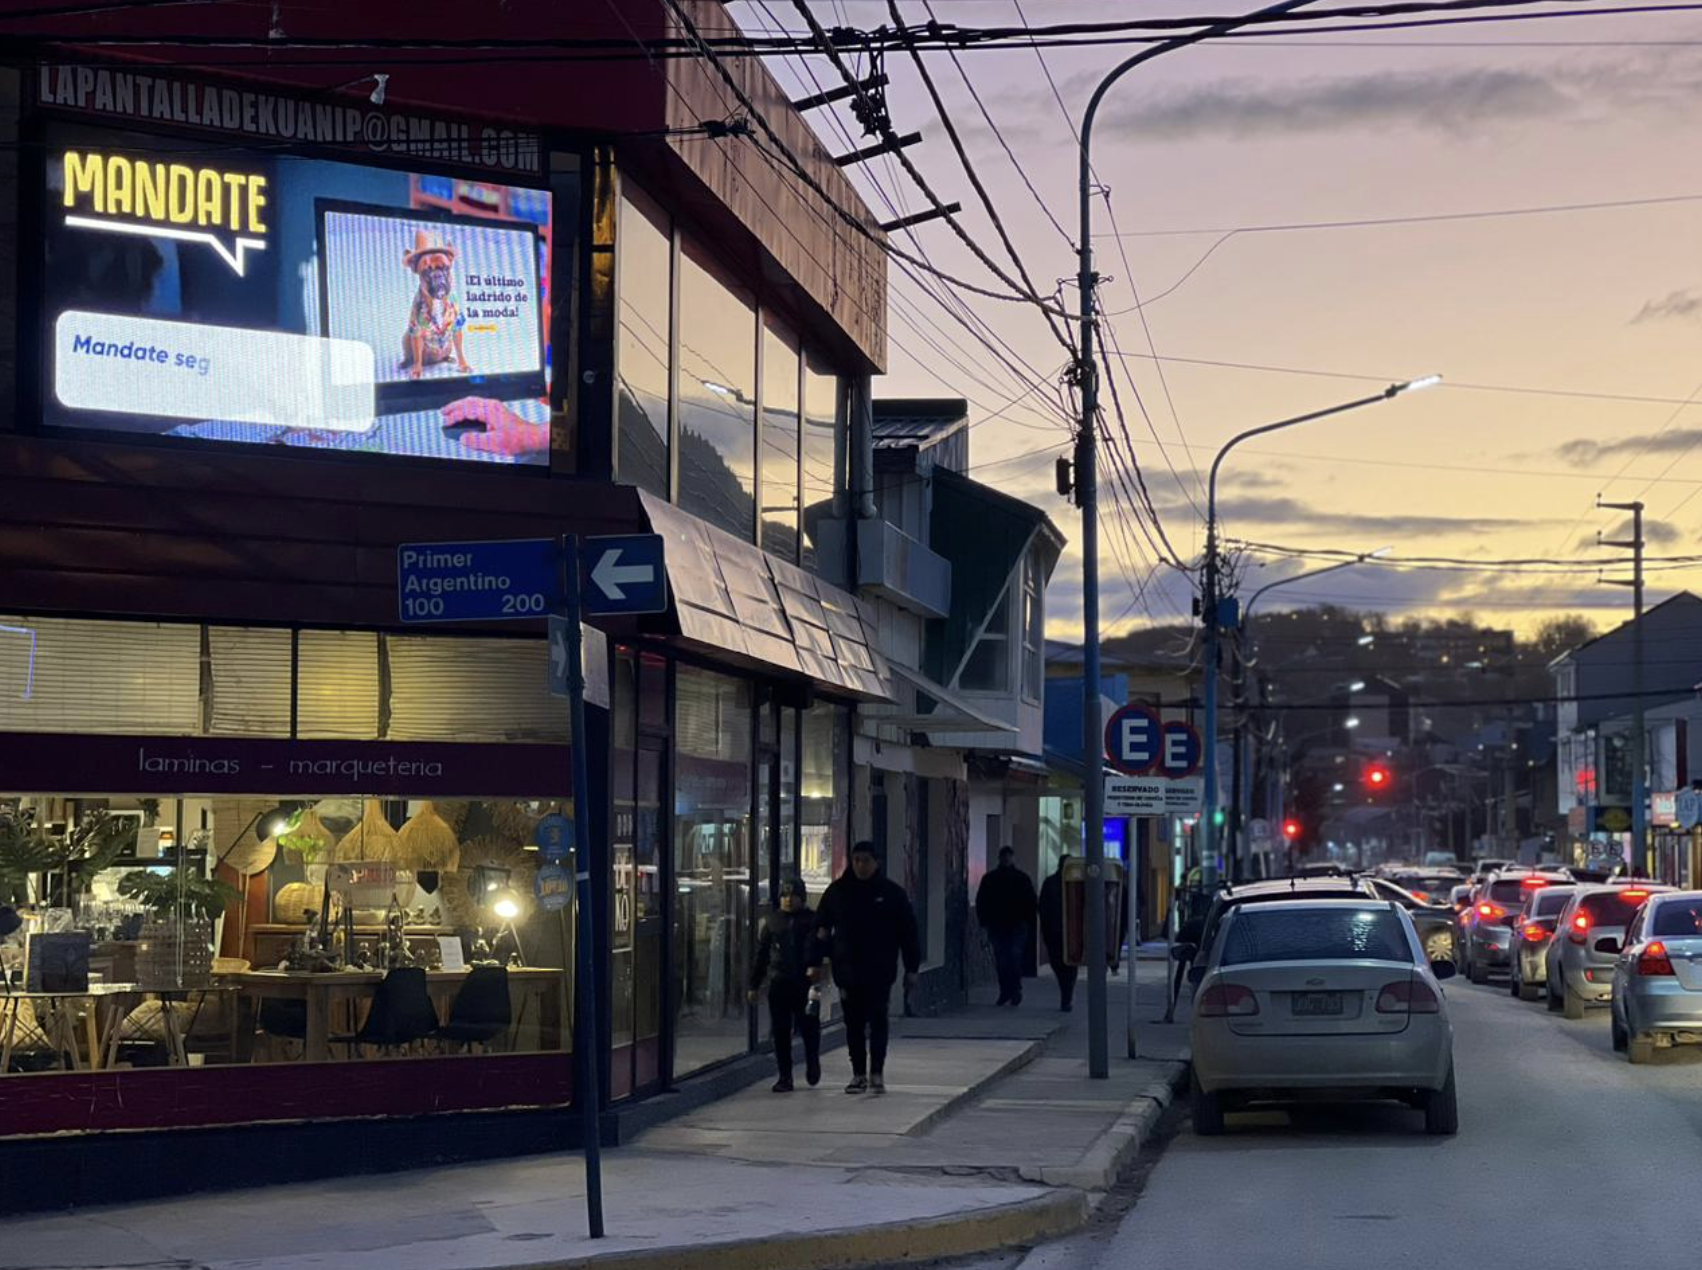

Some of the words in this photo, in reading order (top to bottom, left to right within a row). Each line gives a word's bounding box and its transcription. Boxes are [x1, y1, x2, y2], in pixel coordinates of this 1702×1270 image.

[40, 64, 540, 171] LAPANTALLADEKUANIP@GMAIL.COM
[63, 151, 266, 233] MANDATE
[484, 274, 525, 287] último
[466, 291, 512, 302] ladrido
[514, 292, 529, 302] de
[467, 307, 479, 318] la
[482, 306, 519, 318] moda!
[72, 334, 169, 363] Mandate
[174, 352, 211, 376] seg
[403, 550, 473, 569] Primer
[404, 572, 510, 595] Argentino
[404, 597, 444, 616] 100
[501, 594, 545, 613] 200
[1122, 718, 1149, 760] E
[1165, 733, 1187, 767] E
[138, 748, 240, 774] laminas
[289, 756, 442, 781] marqueteria
